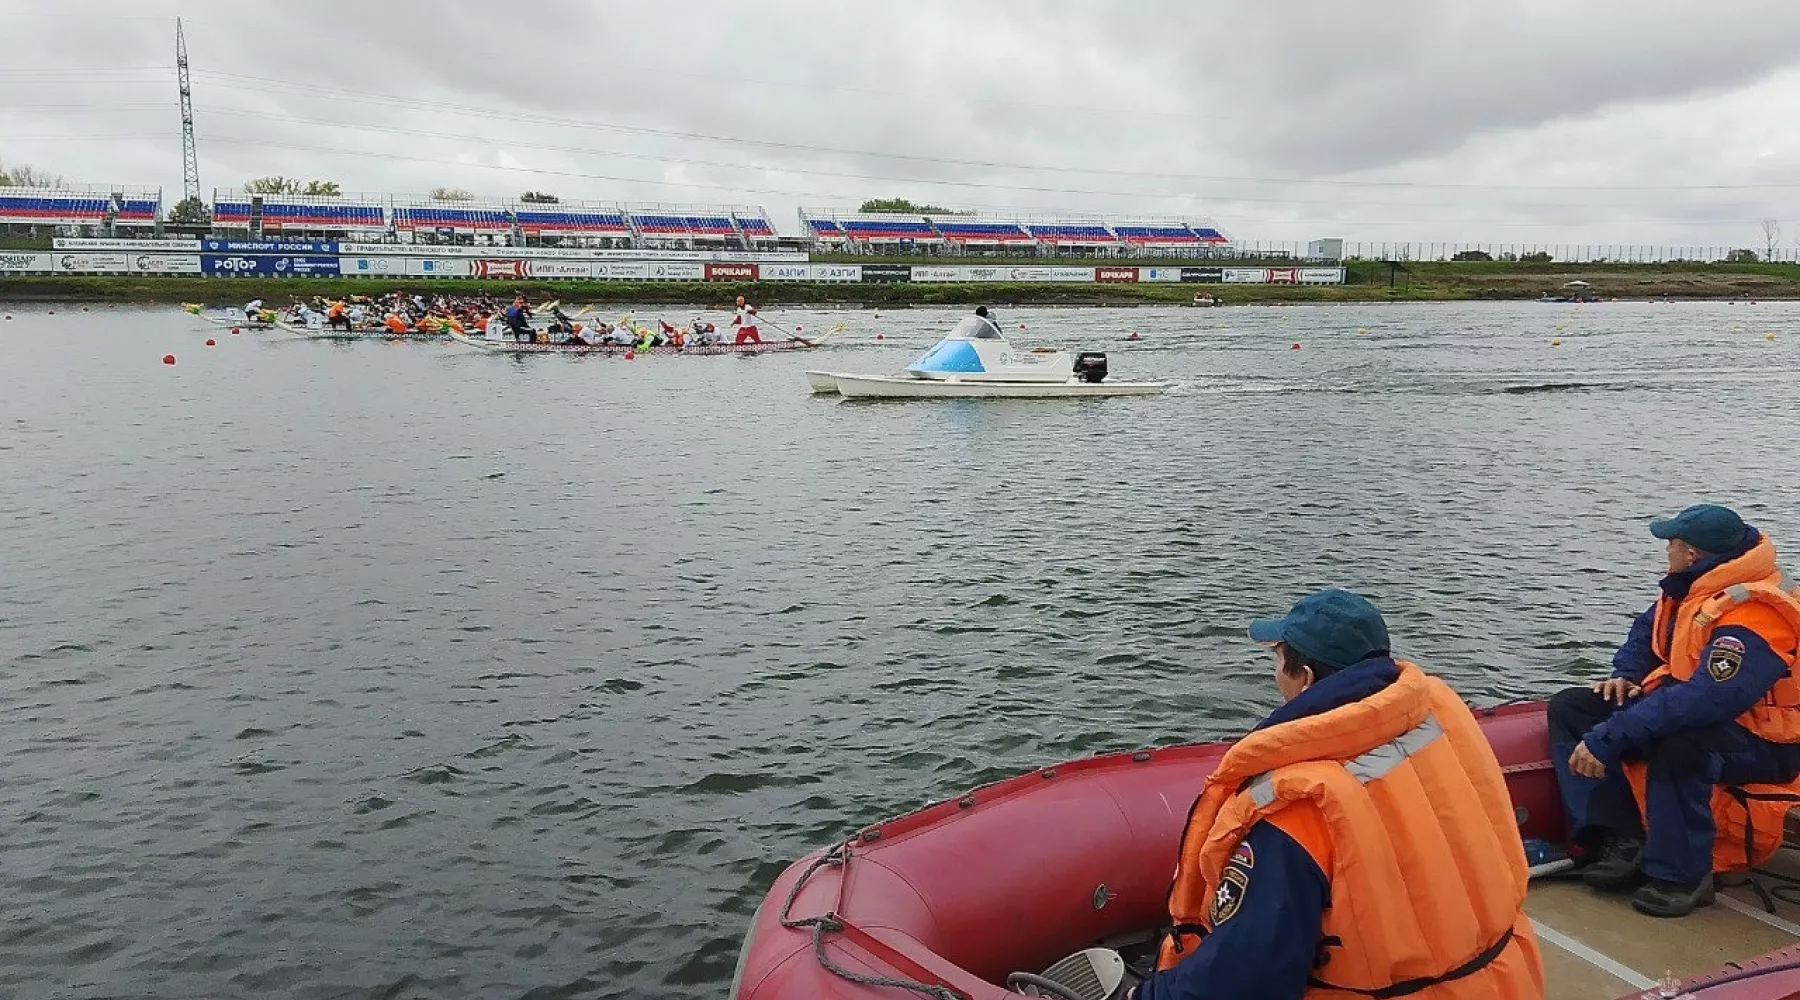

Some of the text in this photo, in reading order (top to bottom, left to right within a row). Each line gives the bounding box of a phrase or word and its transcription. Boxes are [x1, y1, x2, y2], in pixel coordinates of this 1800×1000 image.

[227, 242, 313, 251] МИНСПОРТ РОССИИ
[214, 257, 257, 272] РОТОР
[536, 265, 555, 273] ИПП
[711, 267, 752, 276] БОЧКАРИ
[778, 268, 805, 277] АЗПИ
[829, 269, 856, 277] АЗПИ
[491, 326, 497, 335] 1
